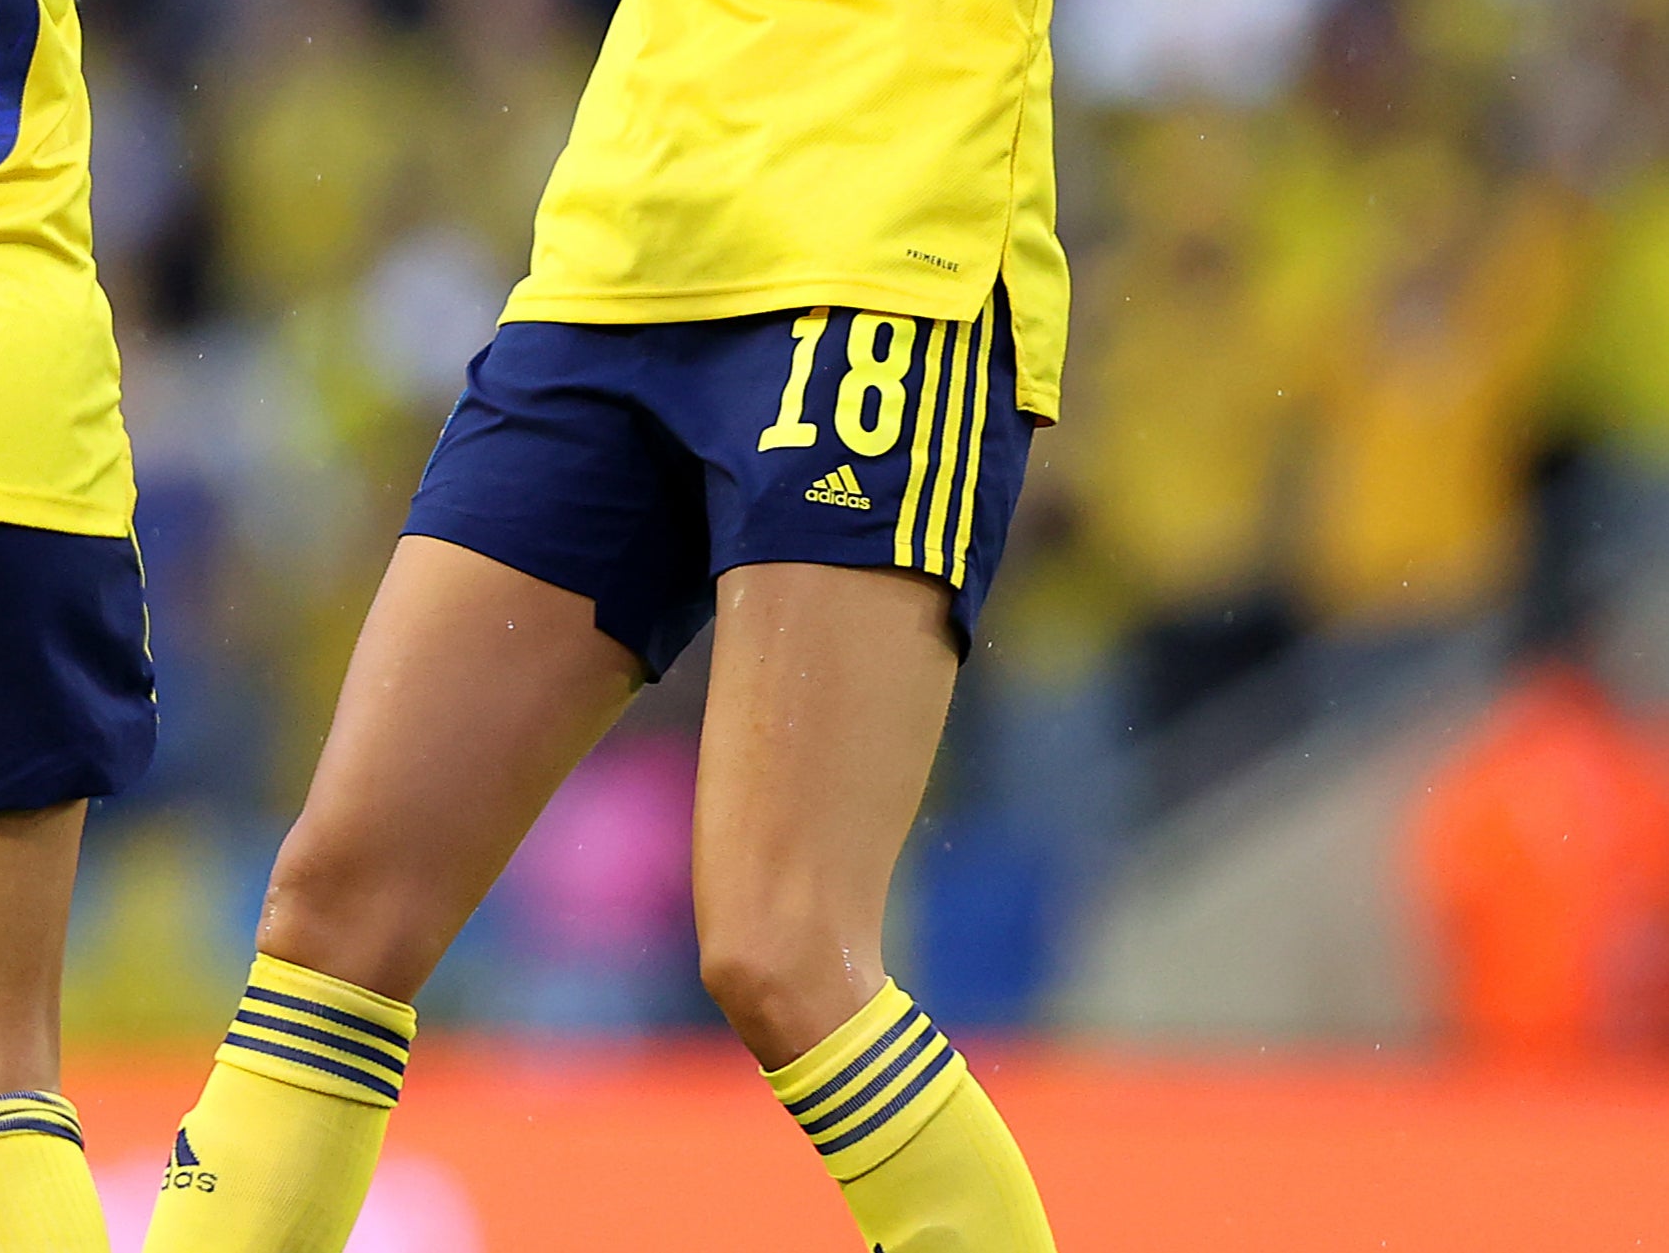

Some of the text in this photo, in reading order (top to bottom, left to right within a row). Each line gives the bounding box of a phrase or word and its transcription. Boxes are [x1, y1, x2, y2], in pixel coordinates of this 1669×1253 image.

[906, 249, 960, 273] PRIMEBLUE
[757, 307, 918, 457] 18
[804, 486, 872, 511] adidas
